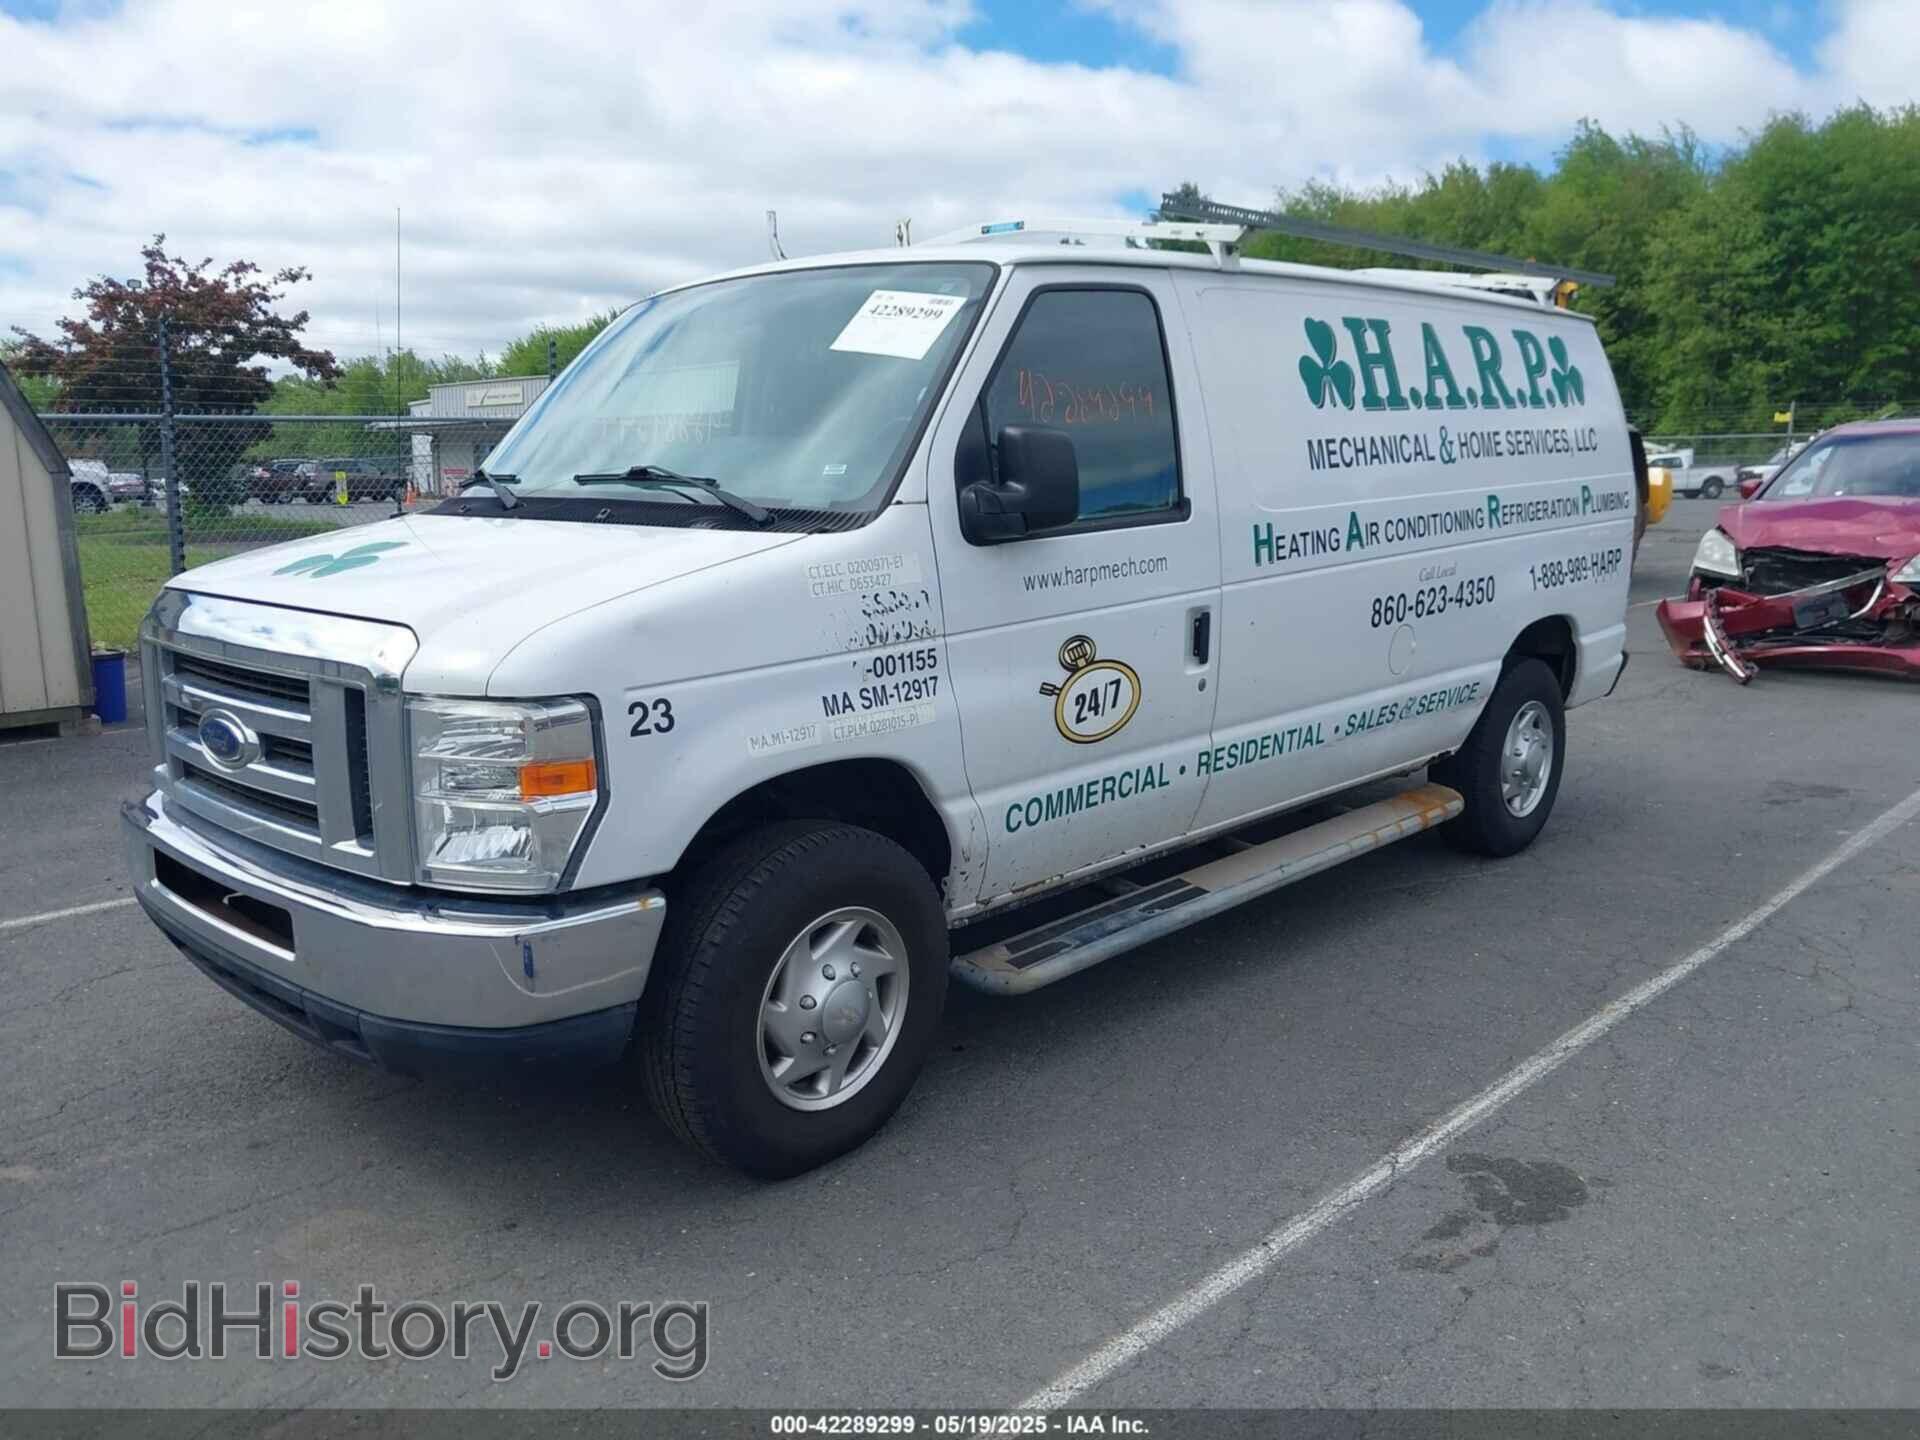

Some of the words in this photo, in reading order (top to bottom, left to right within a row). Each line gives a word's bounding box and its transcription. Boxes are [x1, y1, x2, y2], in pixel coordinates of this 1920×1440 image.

[1307, 433, 1435, 471] MECHANICAL
[1439, 425, 1457, 465] &
[1457, 430, 1503, 460] HOME
[1576, 427, 1598, 453] LLC
[1385, 506, 1485, 543] CONDITIONING
[1023, 555, 1168, 593] www.harpmech.com
[1529, 548, 1622, 591] 1-888-989-HARP
[1371, 575, 1496, 628] 860-623-4350
[628, 698, 675, 737] 23
[822, 691, 856, 718] MA
[859, 675, 938, 710] SM-12917
[1075, 678, 1122, 725] 24/7
[1006, 763, 1170, 833] COMMERCIAL
[1197, 722, 1325, 777] RESIDENTIAL
[1345, 702, 1399, 736] SALES
[1415, 682, 1480, 716] SERVICE
